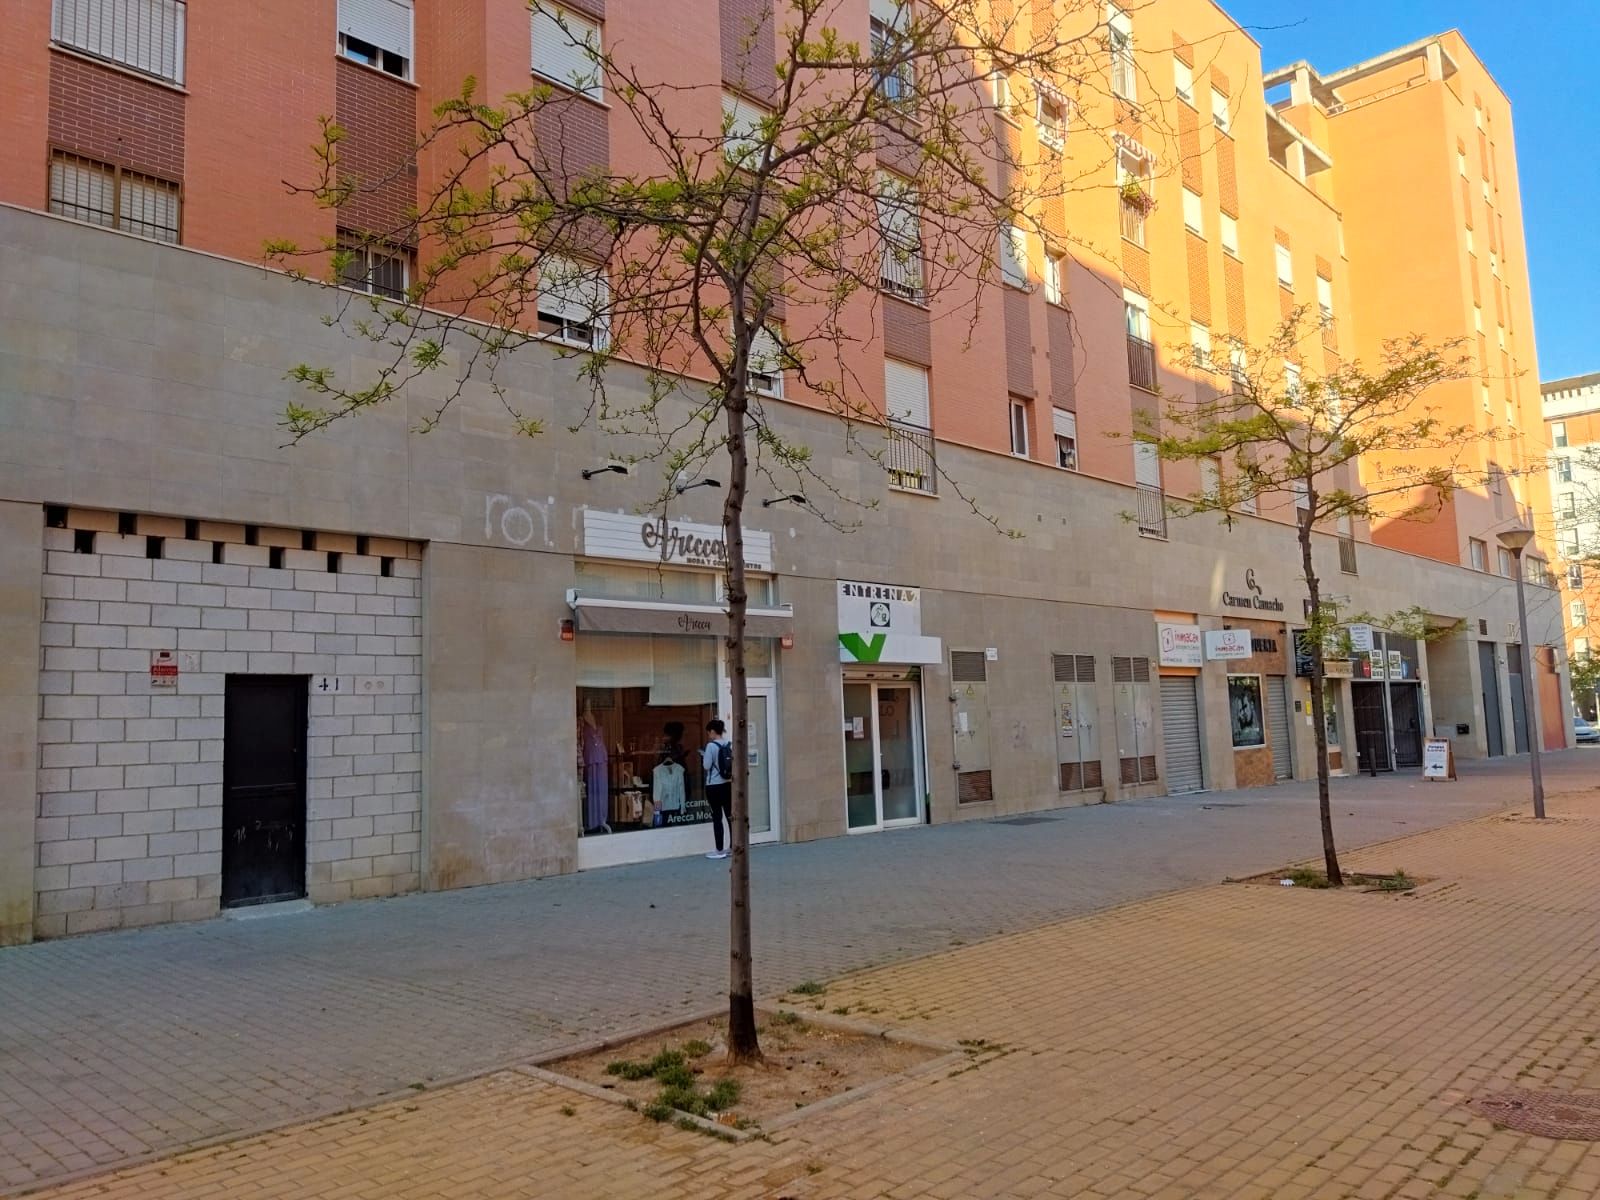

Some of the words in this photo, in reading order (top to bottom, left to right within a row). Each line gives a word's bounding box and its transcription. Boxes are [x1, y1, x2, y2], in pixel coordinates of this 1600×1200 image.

[1222, 591, 1251, 608] Carmen
[1253, 595, 1284, 612] Camacho
[667, 814, 695, 823] Arecca
